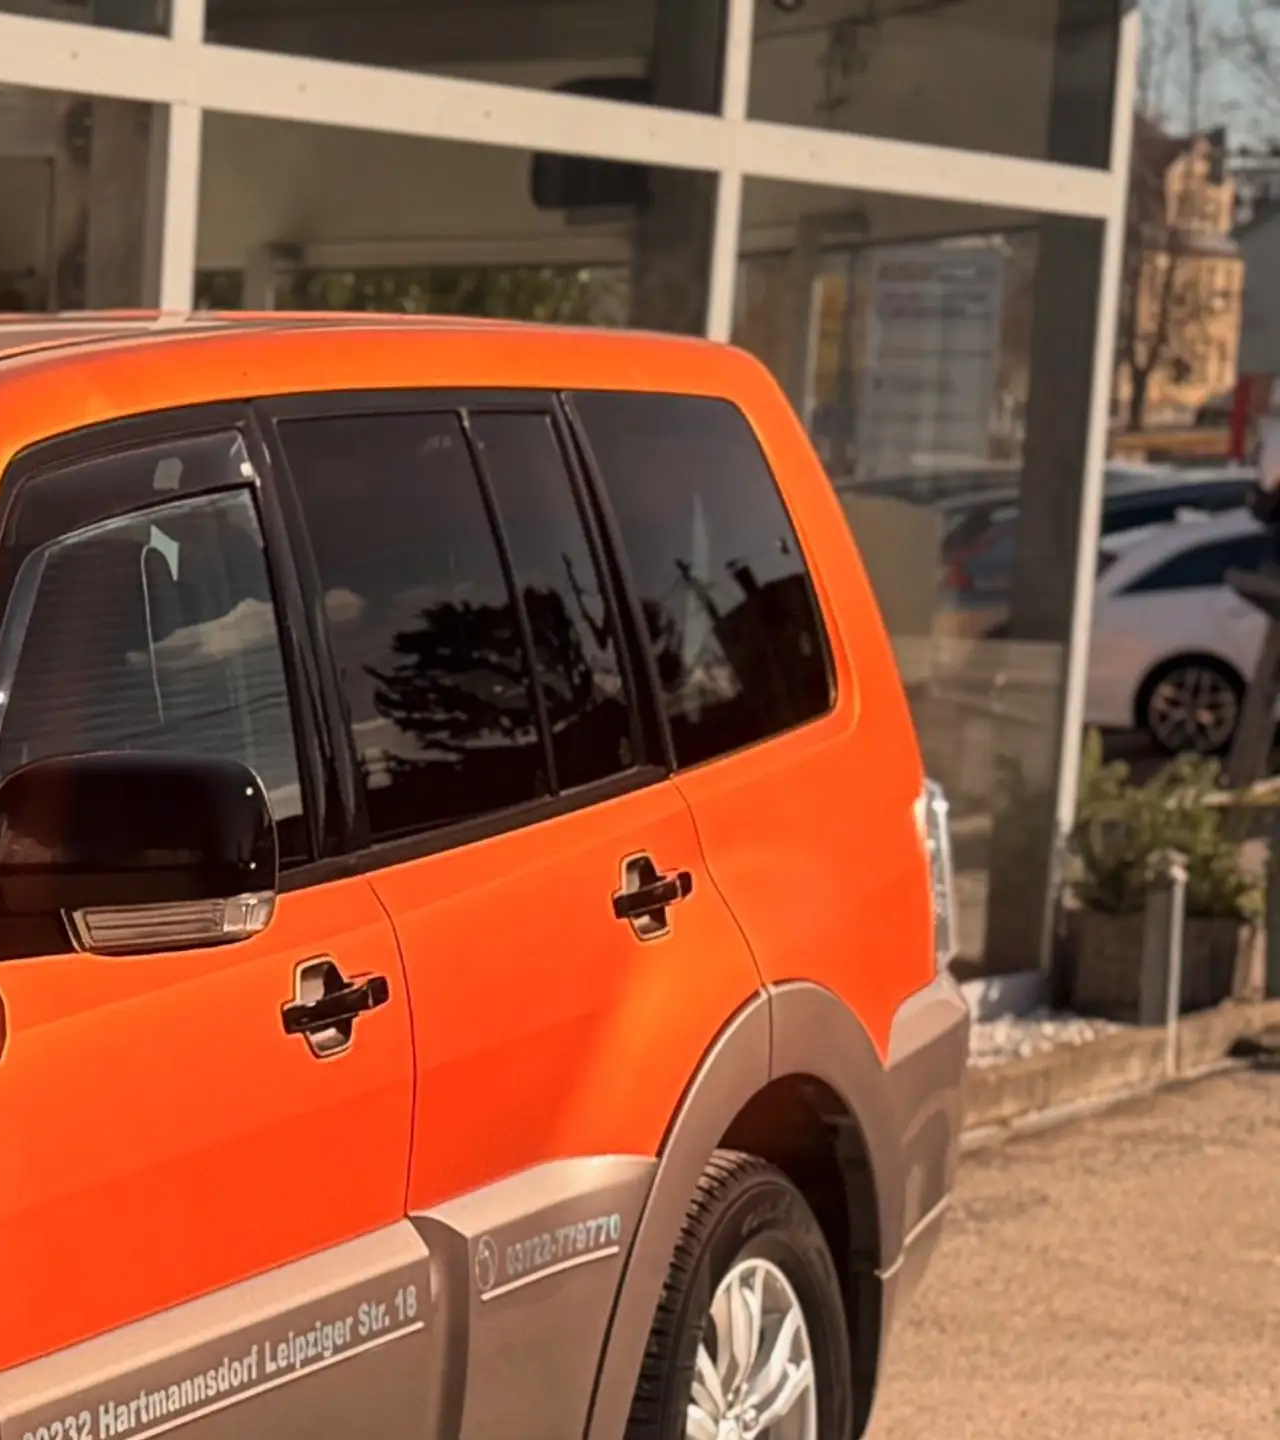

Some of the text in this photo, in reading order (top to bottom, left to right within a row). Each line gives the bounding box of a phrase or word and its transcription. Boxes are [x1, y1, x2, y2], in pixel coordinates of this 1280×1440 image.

[98, 1344, 258, 1440] Hartmannsdorf
[265, 1316, 354, 1374] Leipziger
[357, 1301, 390, 1336] Str.
[394, 1284, 417, 1321] 18
